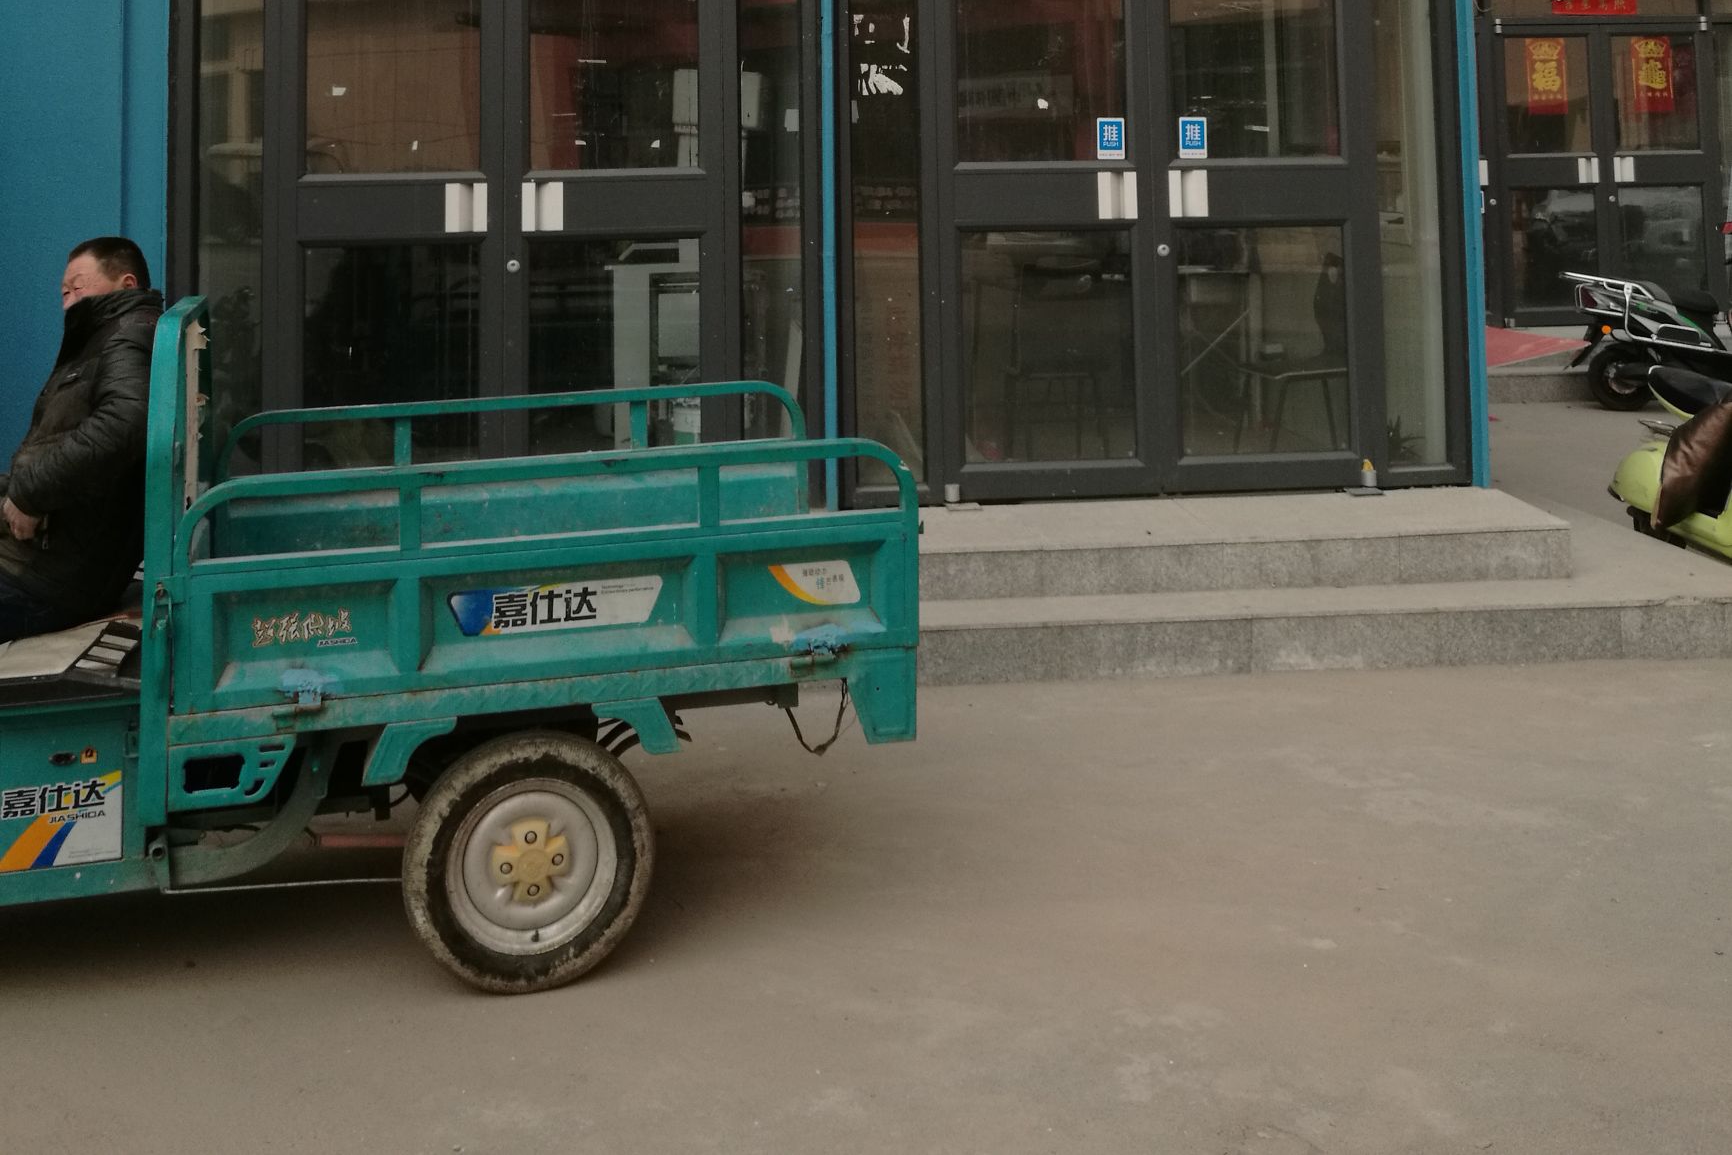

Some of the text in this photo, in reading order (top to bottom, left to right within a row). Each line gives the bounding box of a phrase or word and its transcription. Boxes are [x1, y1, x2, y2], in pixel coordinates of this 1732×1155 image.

[1103, 124, 1119, 141] 推
[1185, 123, 1201, 141] 推
[493, 586, 598, 629] 嘉仕达
[2, 779, 107, 819] 嘉仕达
[48, 809, 107, 824] JIASHIDA
